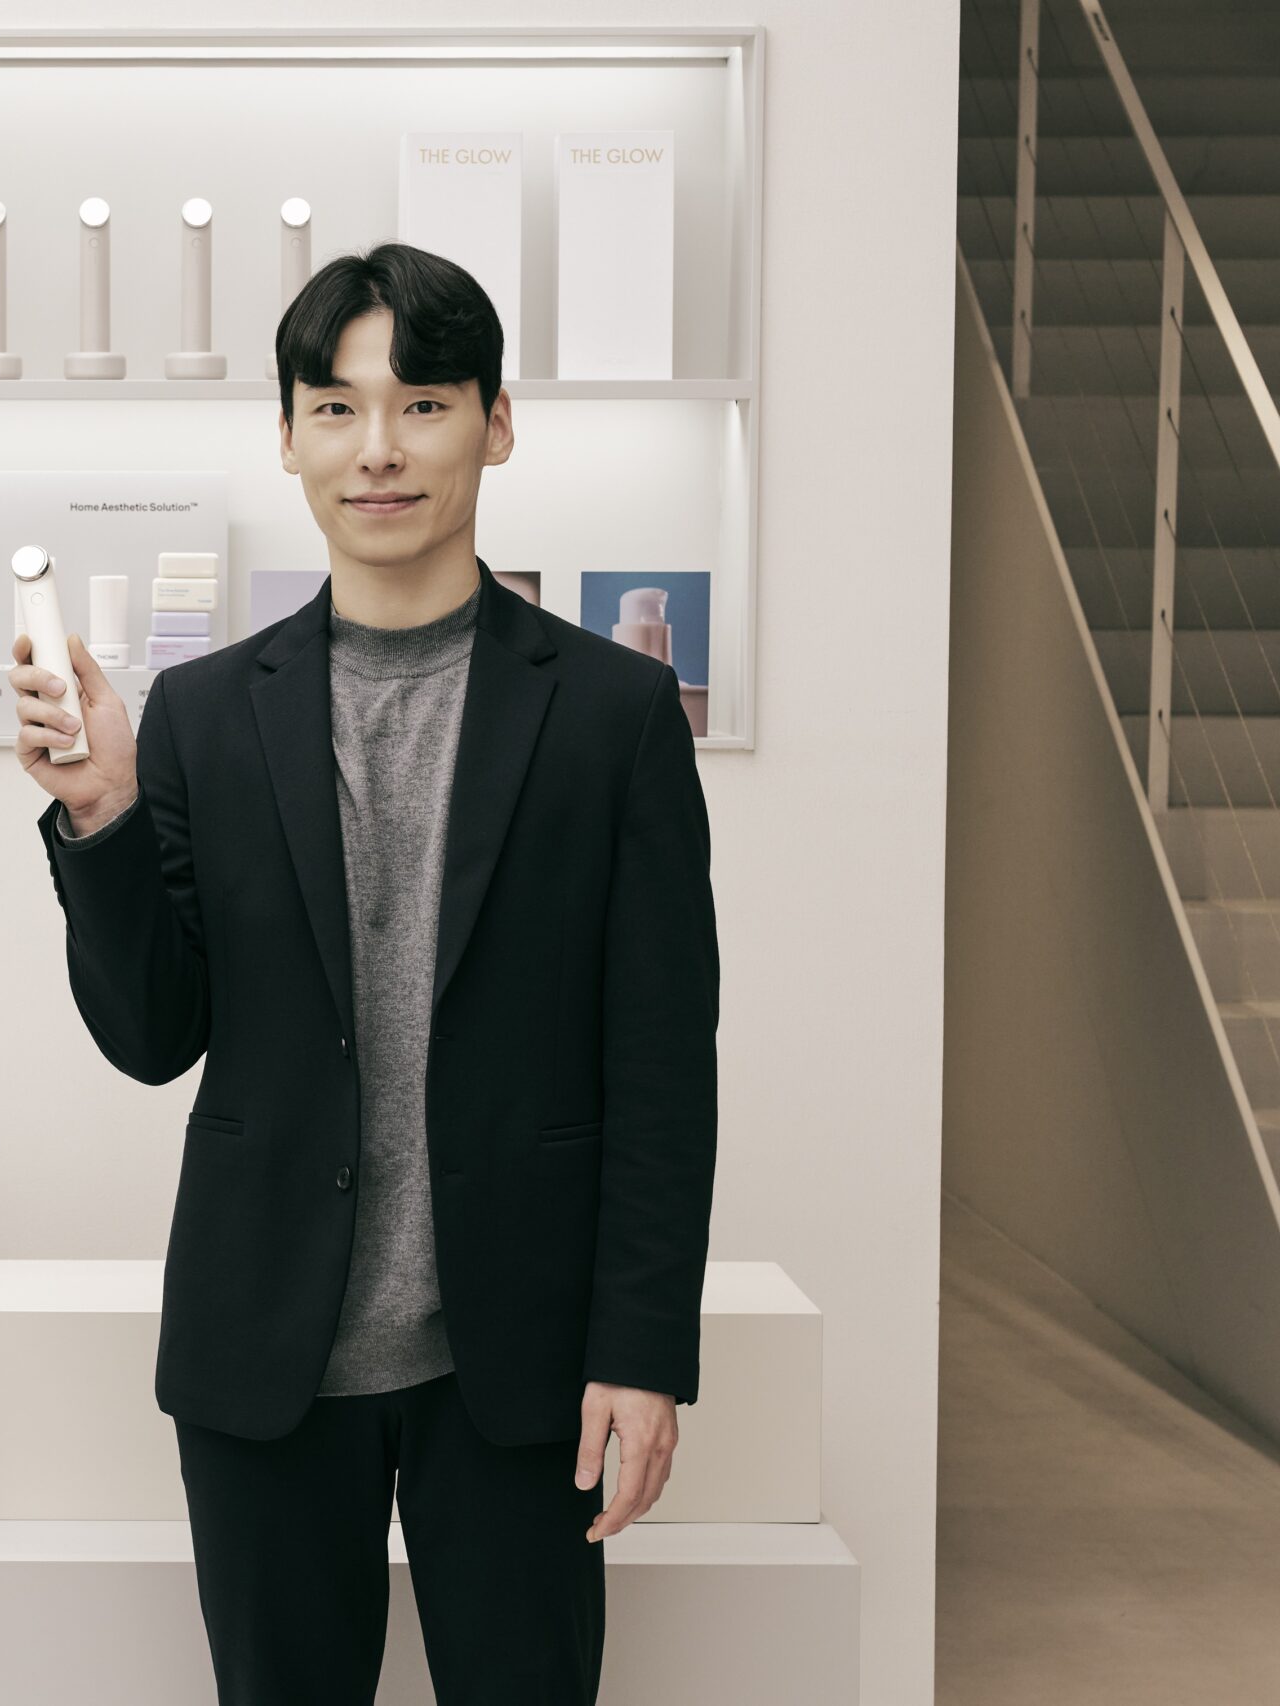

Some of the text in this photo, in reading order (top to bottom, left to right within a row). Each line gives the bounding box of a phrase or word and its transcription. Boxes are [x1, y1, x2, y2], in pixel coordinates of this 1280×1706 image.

[419, 148, 512, 164] THE GLOW
[571, 148, 664, 164] THE GLOW
[70, 502, 99, 512] Home
[102, 502, 148, 512] Aesthetic
